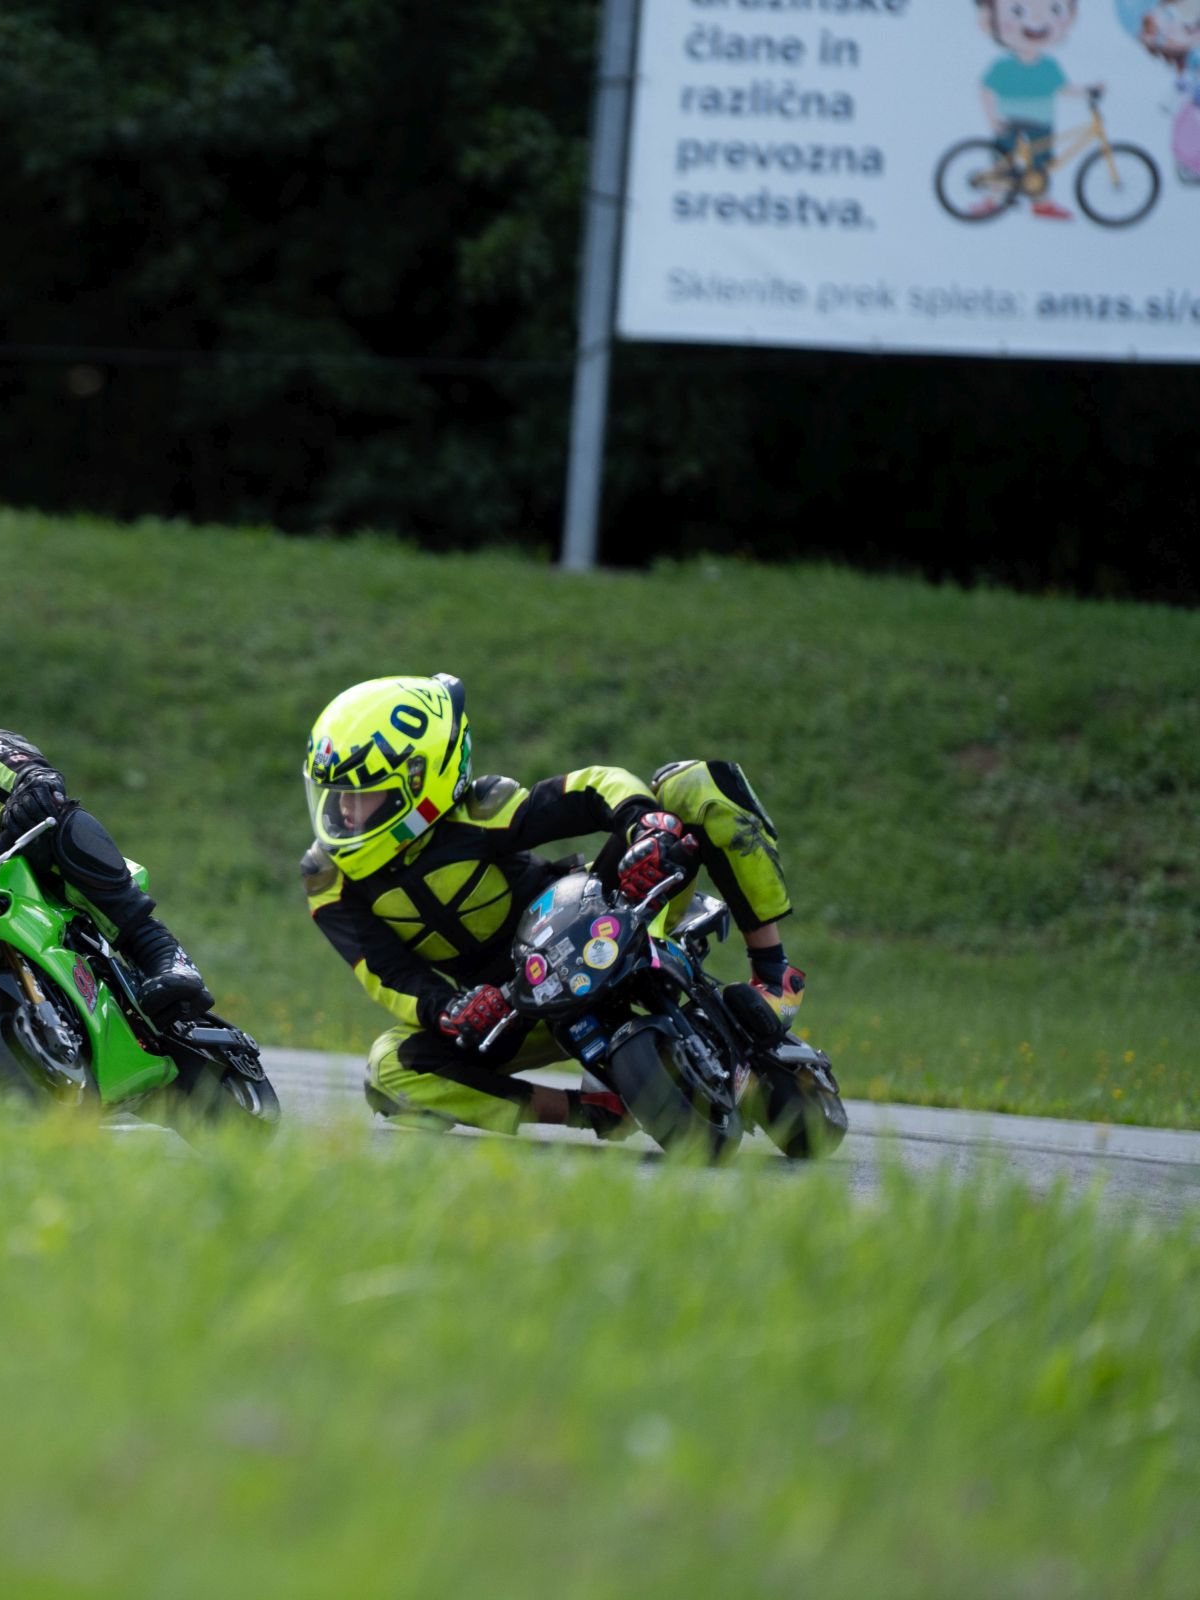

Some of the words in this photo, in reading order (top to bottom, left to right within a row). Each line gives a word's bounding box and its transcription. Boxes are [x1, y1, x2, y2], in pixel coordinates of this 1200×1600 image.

[684, 22, 805, 64] člane
[818, 28, 860, 67] in
[680, 79, 855, 121] različna
[676, 139, 885, 176] prevozna
[672, 187, 877, 231] sredstva.
